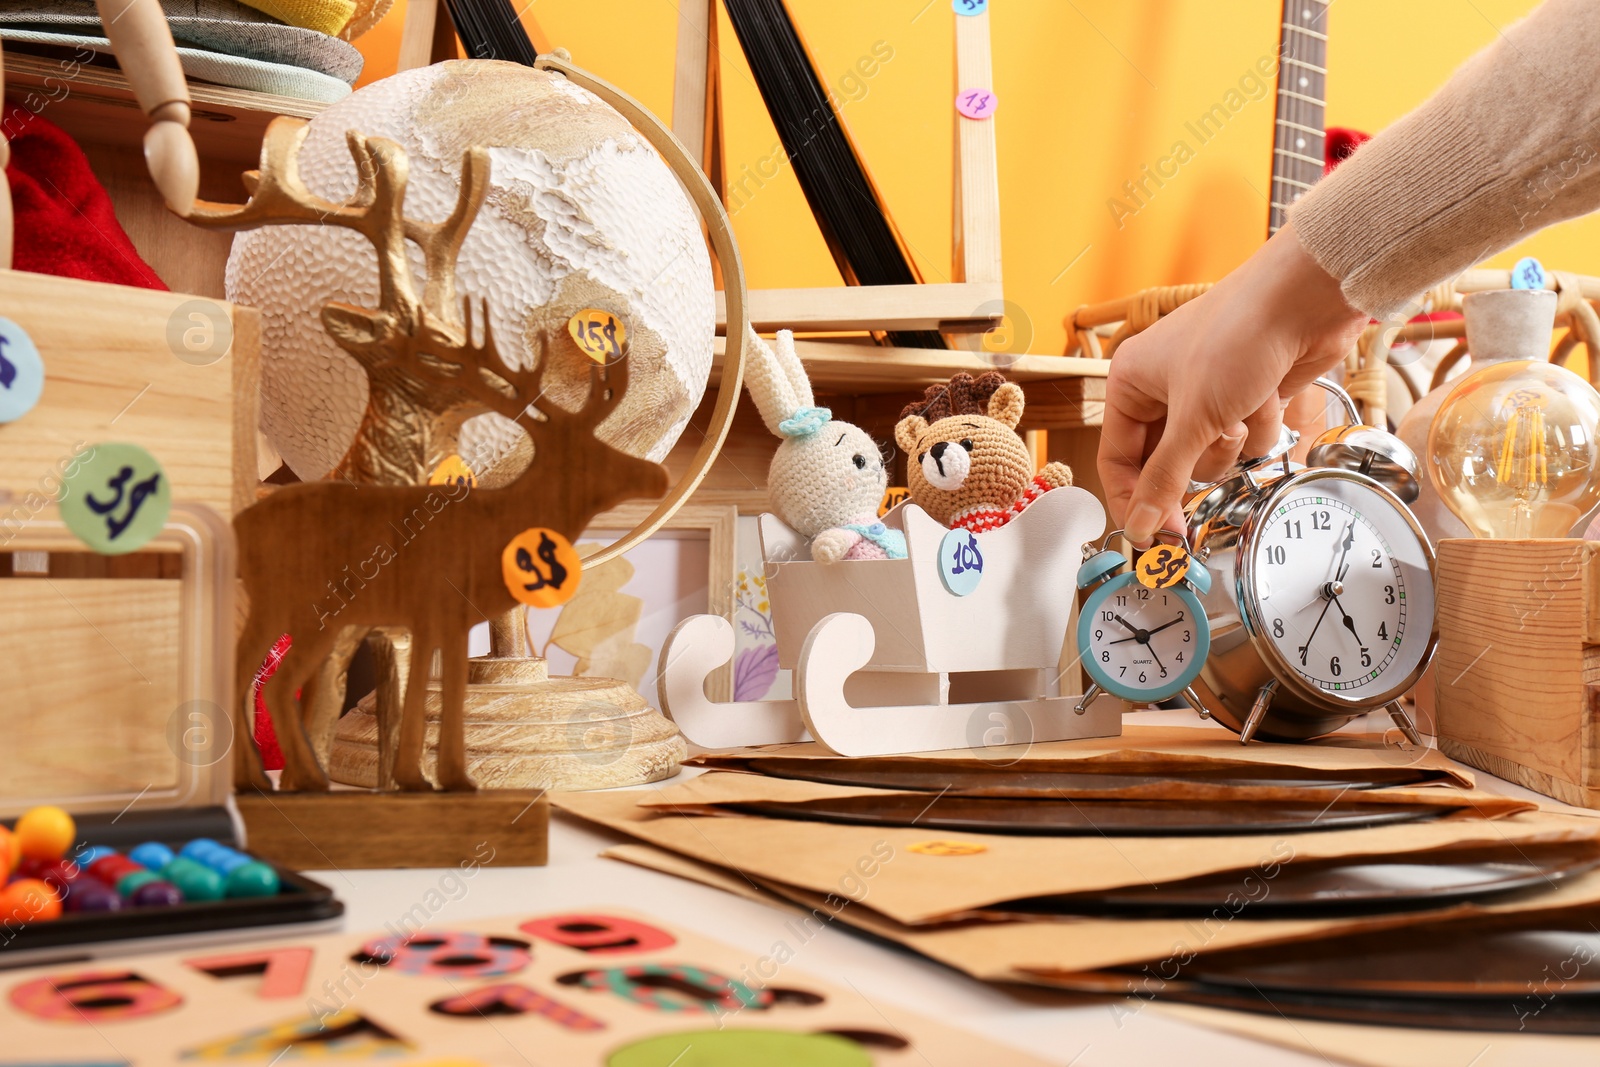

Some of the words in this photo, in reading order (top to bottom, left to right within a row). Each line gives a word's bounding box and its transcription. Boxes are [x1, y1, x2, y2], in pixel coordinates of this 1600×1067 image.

[965, 93, 990, 114] 1$
[577, 316, 621, 358] 15$
[84, 466, 160, 541] 3$
[1284, 519, 1303, 539] 11
[1311, 511, 1331, 530] 12
[516, 531, 567, 591] 9$
[952, 533, 983, 574] 10$
[1265, 545, 1286, 565] 10
[1371, 549, 1382, 568] 2
[1145, 549, 1189, 588] 3$
[1116, 596, 1126, 606] 11
[1136, 589, 1149, 600] 12
[1384, 585, 1395, 604] 3
[1101, 611, 1114, 621] 10
[1177, 611, 1184, 621] 2
[1095, 629, 1103, 641] 9
[1182, 630, 1191, 642] 3
[1273, 618, 1285, 638] 8
[1377, 621, 1388, 640] 4
[1102, 651, 1110, 662] 8
[1175, 651, 1184, 663] 4
[1298, 646, 1308, 666] 7
[1360, 648, 1371, 667] 5
[1120, 666, 1127, 677] 7
[1159, 667, 1168, 678] 5
[1330, 656, 1341, 676] 6
[1138, 671, 1147, 683] 6
